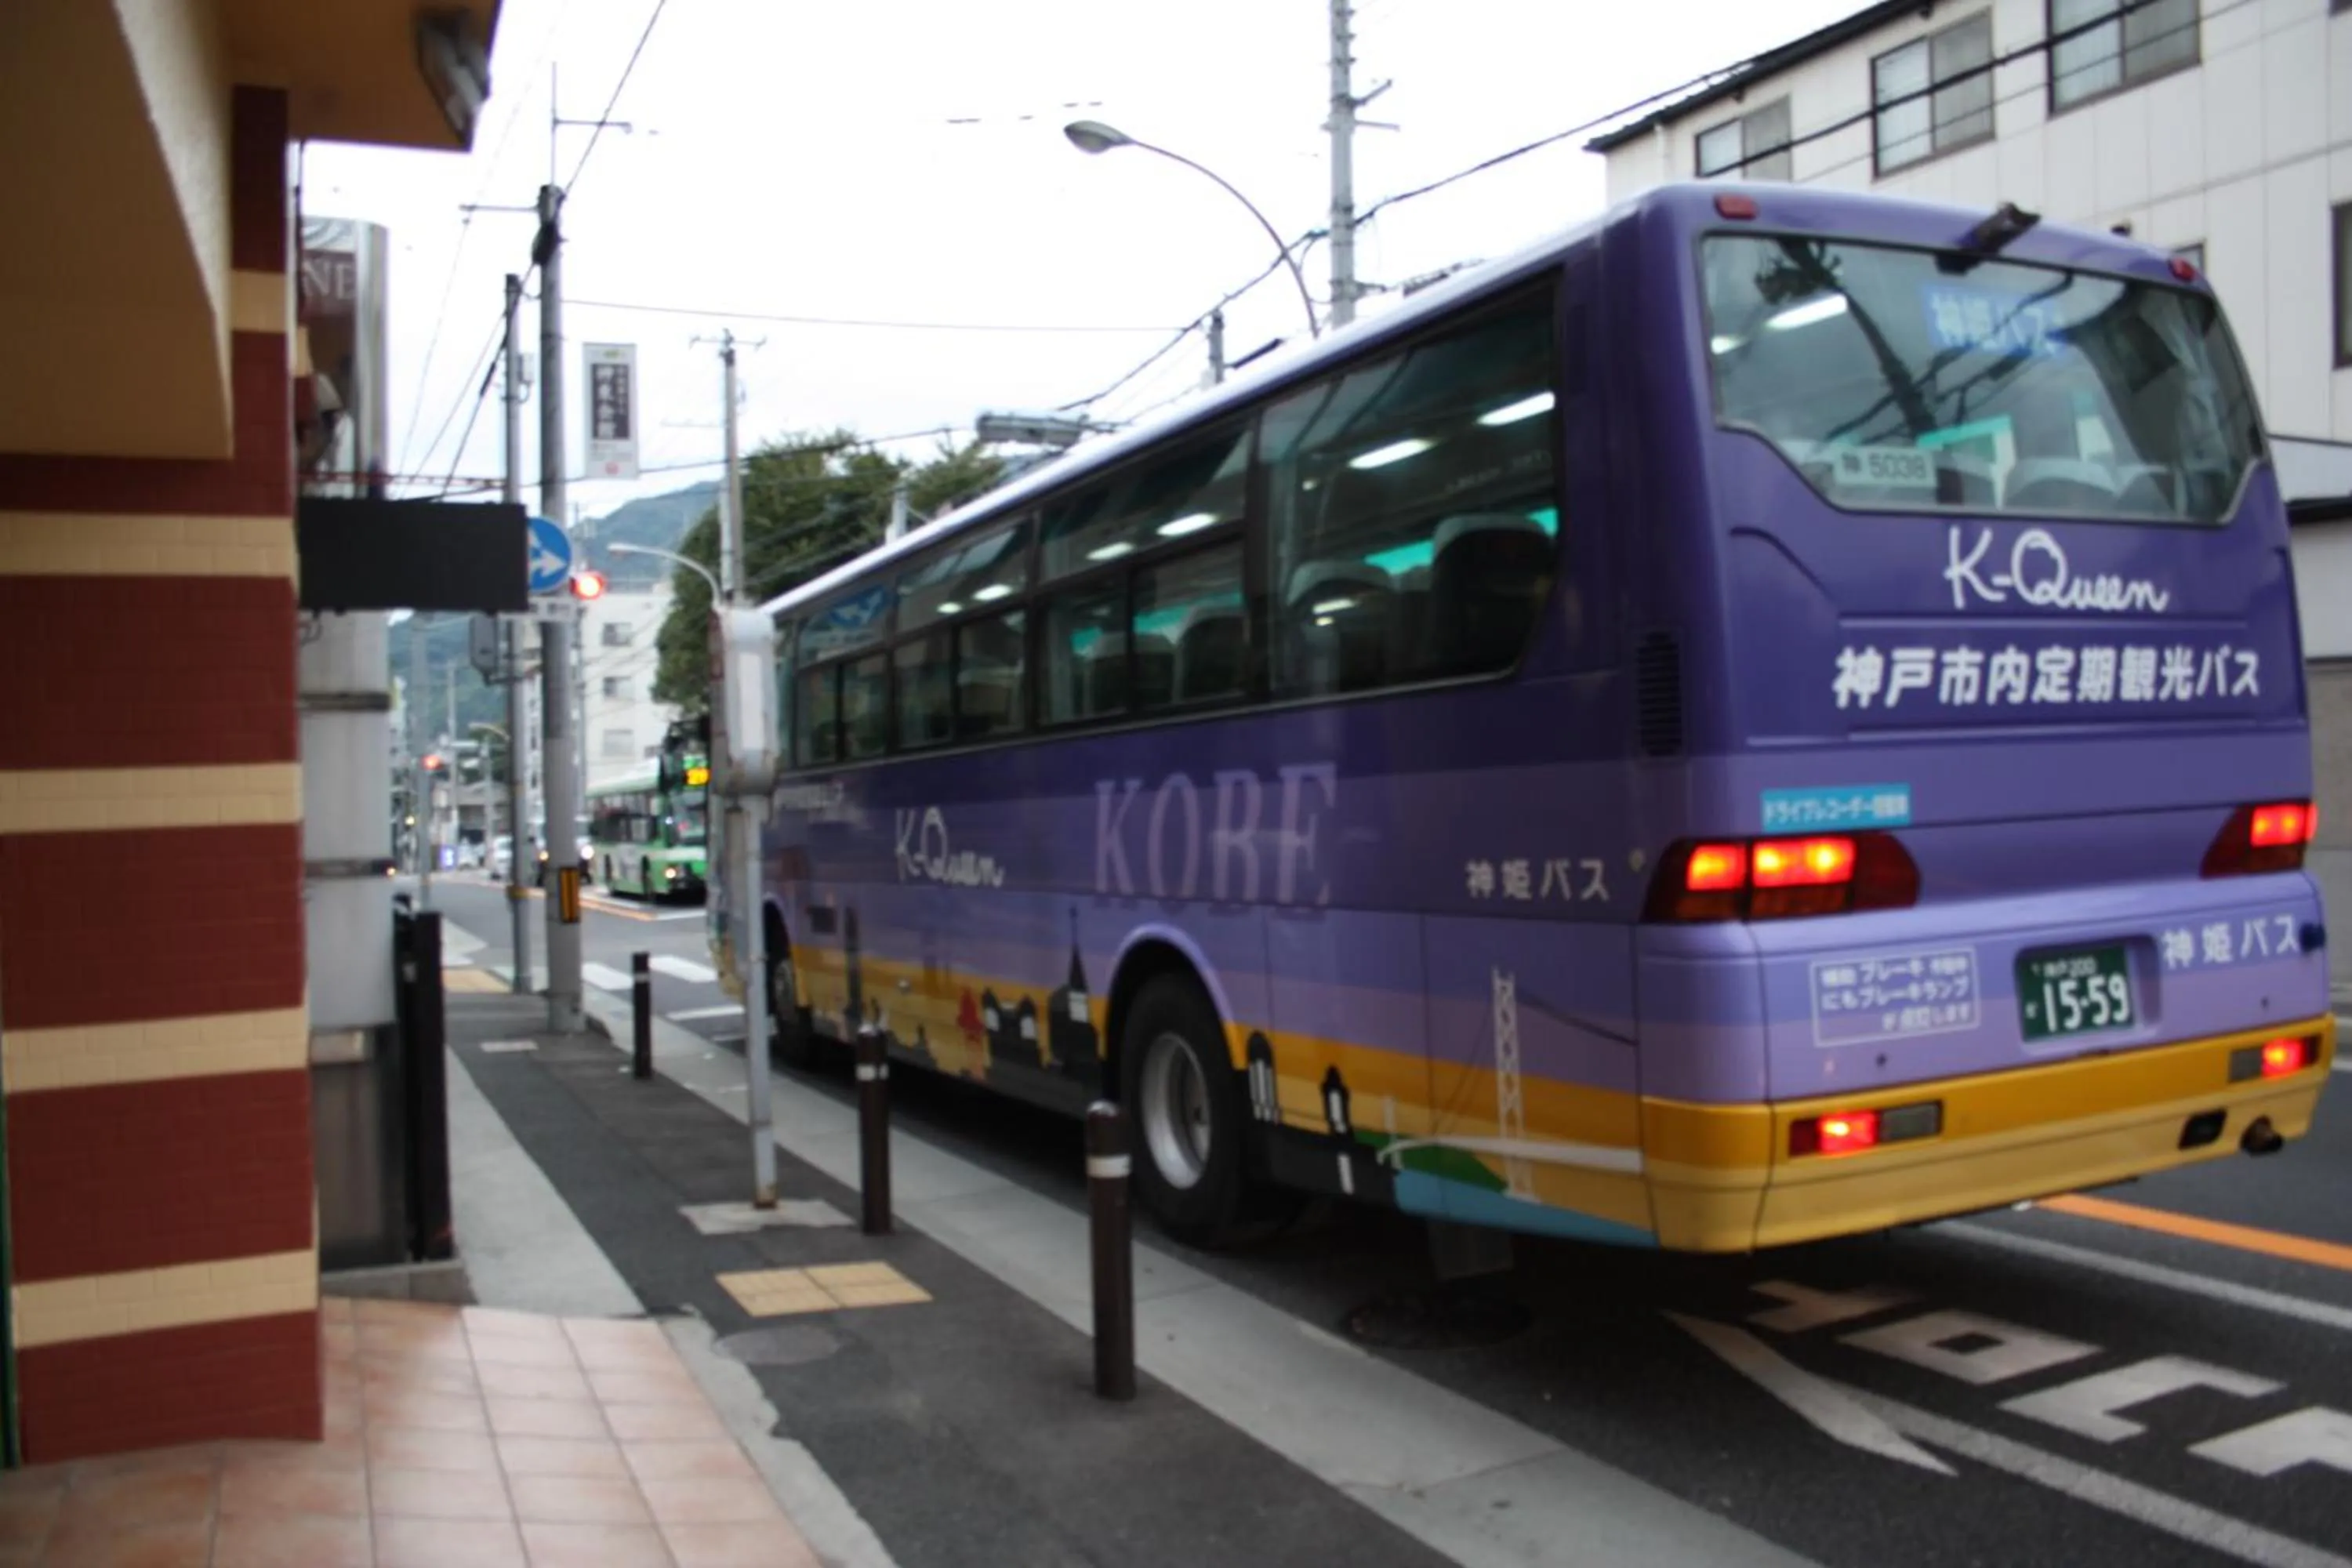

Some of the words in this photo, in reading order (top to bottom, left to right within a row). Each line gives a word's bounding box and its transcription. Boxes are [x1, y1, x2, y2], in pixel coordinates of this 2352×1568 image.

[1944, 526, 2169, 613] K-Queen
[1831, 646, 2261, 709] 神戸市内定期観光バス
[1097, 760, 1338, 907] KOBE
[1465, 858, 1610, 901] 神姫バス
[2162, 914, 2301, 969] 神姫バス
